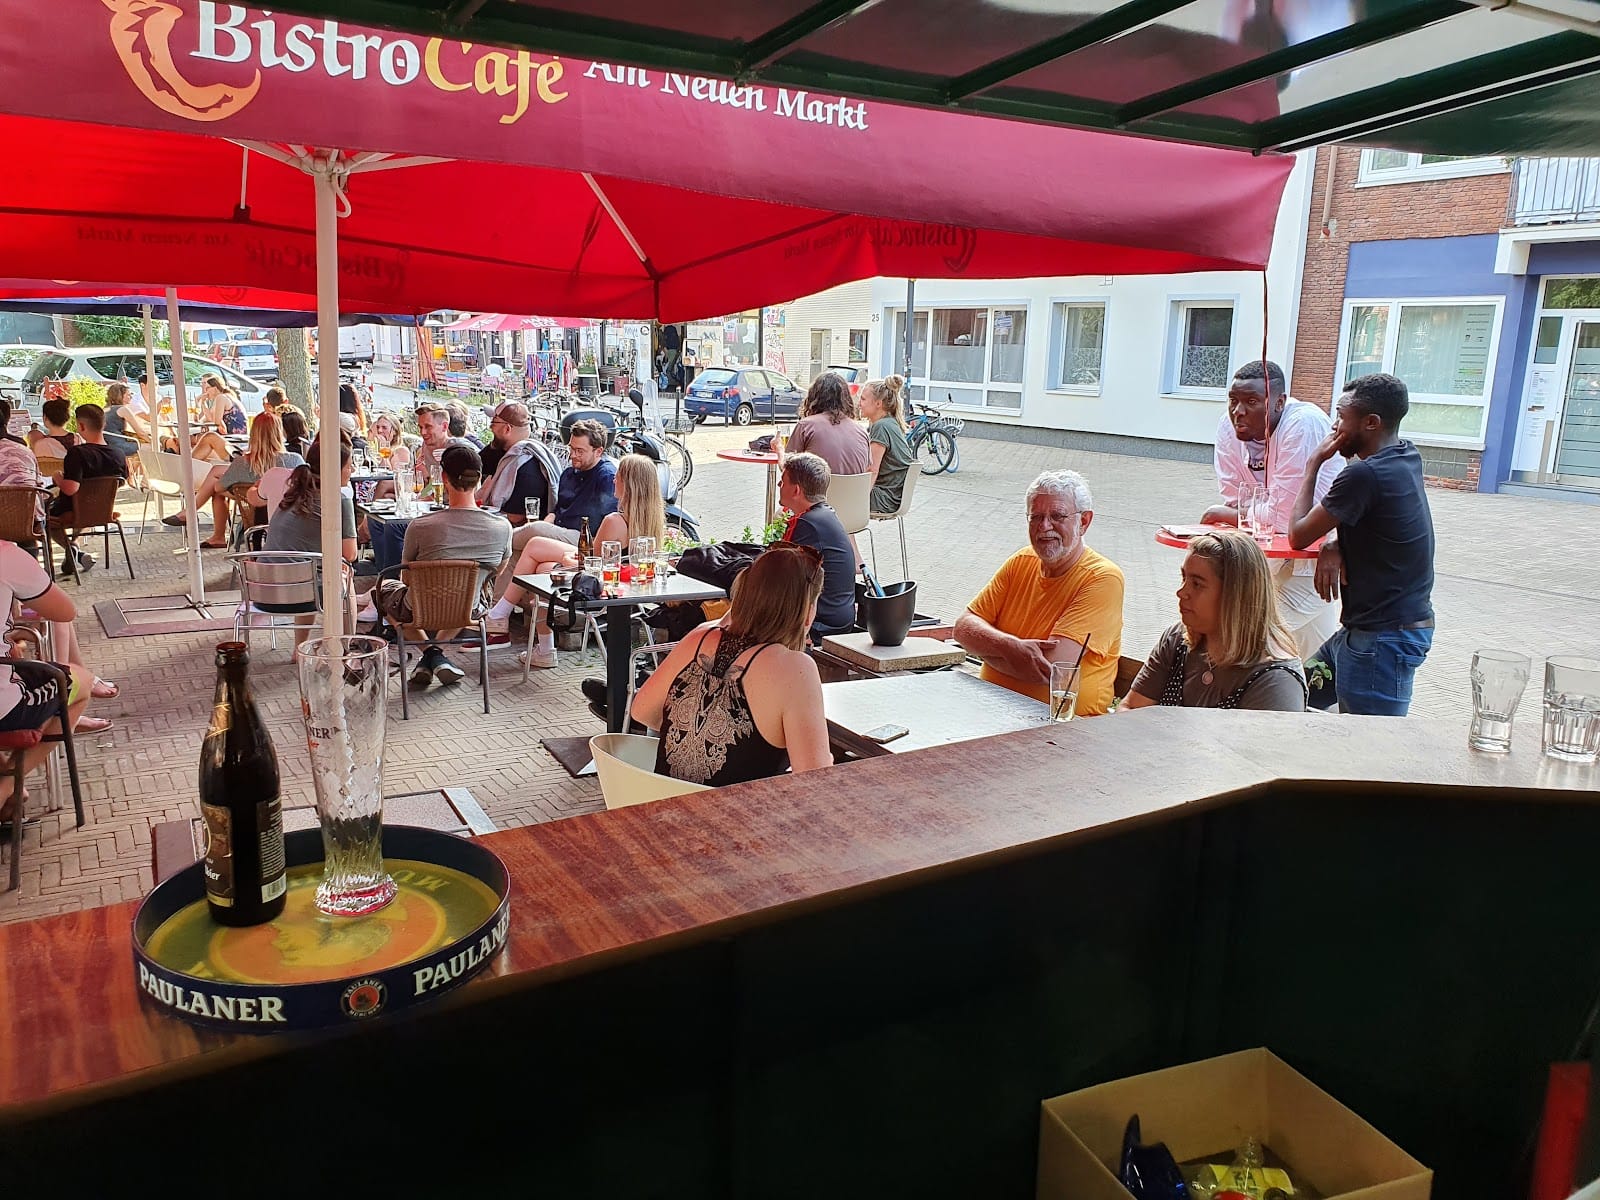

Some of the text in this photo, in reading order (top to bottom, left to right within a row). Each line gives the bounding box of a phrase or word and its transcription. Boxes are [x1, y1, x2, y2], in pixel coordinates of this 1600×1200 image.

[583, 61, 651, 88] Am
[660, 72, 767, 111] Neuen
[774, 88, 869, 131] Markt
[871, 313, 880, 322] 25
[413, 902, 510, 996] PAULANE
[138, 961, 287, 1022] PAULANER
